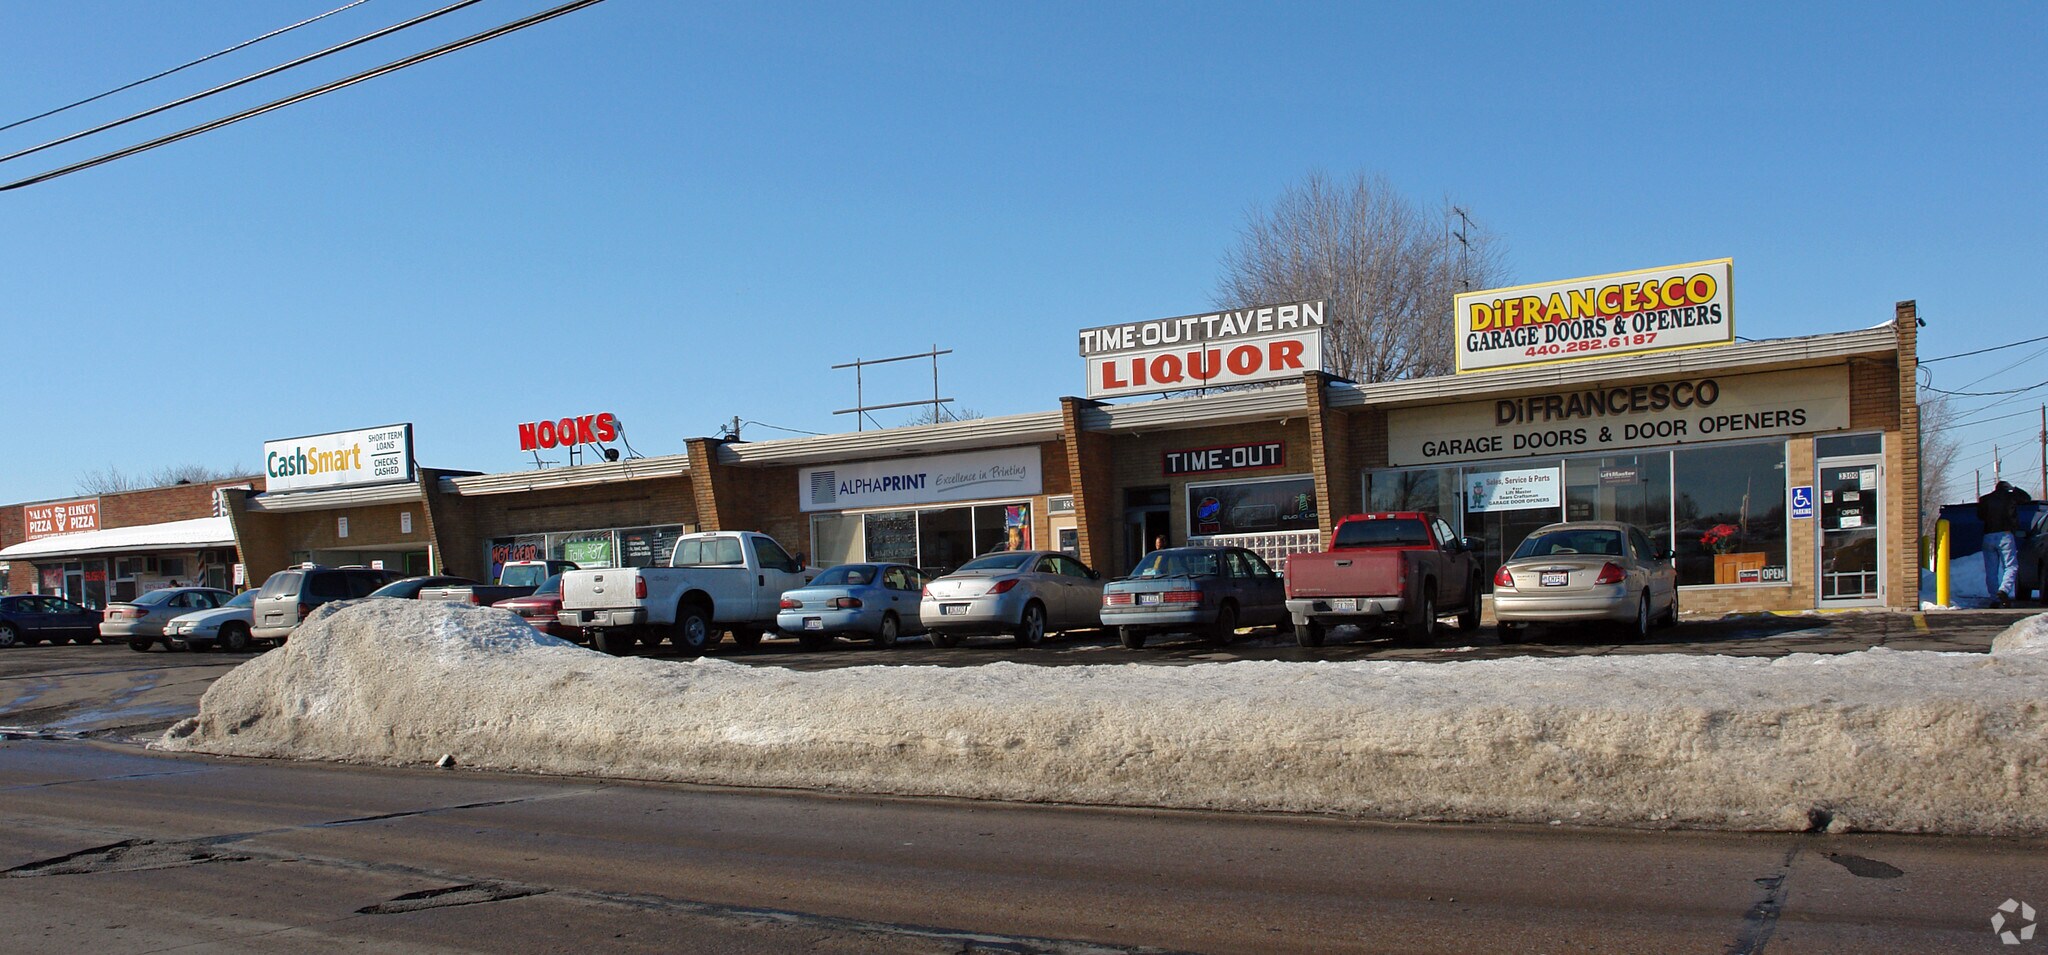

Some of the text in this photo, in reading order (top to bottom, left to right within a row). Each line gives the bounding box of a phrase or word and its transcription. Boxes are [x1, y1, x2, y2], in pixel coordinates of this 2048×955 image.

[1470, 272, 1717, 332] DiFRANCESCO
[1079, 301, 1324, 353] TIME-OUT TAVERN
[1466, 303, 1722, 353] GARAGE DOORS & OPENERS
[1524, 332, 1658, 357] 440.282.6187
[1102, 340, 1304, 389] LIQUOR
[1495, 378, 1719, 427] DiFRANCESCO
[368, 430, 403, 443] SHORT TERM
[518, 412, 616, 451] NOOKS
[1422, 408, 1807, 458] GARAGE DOORS & DOOR OPENERS
[376, 440, 395, 451] LOANS
[1167, 443, 1280, 473] TIME-OUT
[267, 442, 361, 479] CashSmart
[374, 457, 399, 468] CHECKS
[374, 466, 400, 477] CASHED
[839, 464, 1026, 496] ALPHAPRINT Excellence in Printing
[1504, 475, 1527, 484] Service
[1528, 474, 1533, 482] &
[1534, 474, 1550, 482] Parts
[1839, 472, 1859, 480] 3300
[29, 515, 95, 533] PIZZA PIZZA
[1841, 508, 1860, 516] OPEN
[568, 549, 584, 561] Talk
[1762, 568, 1784, 580] OPEN
